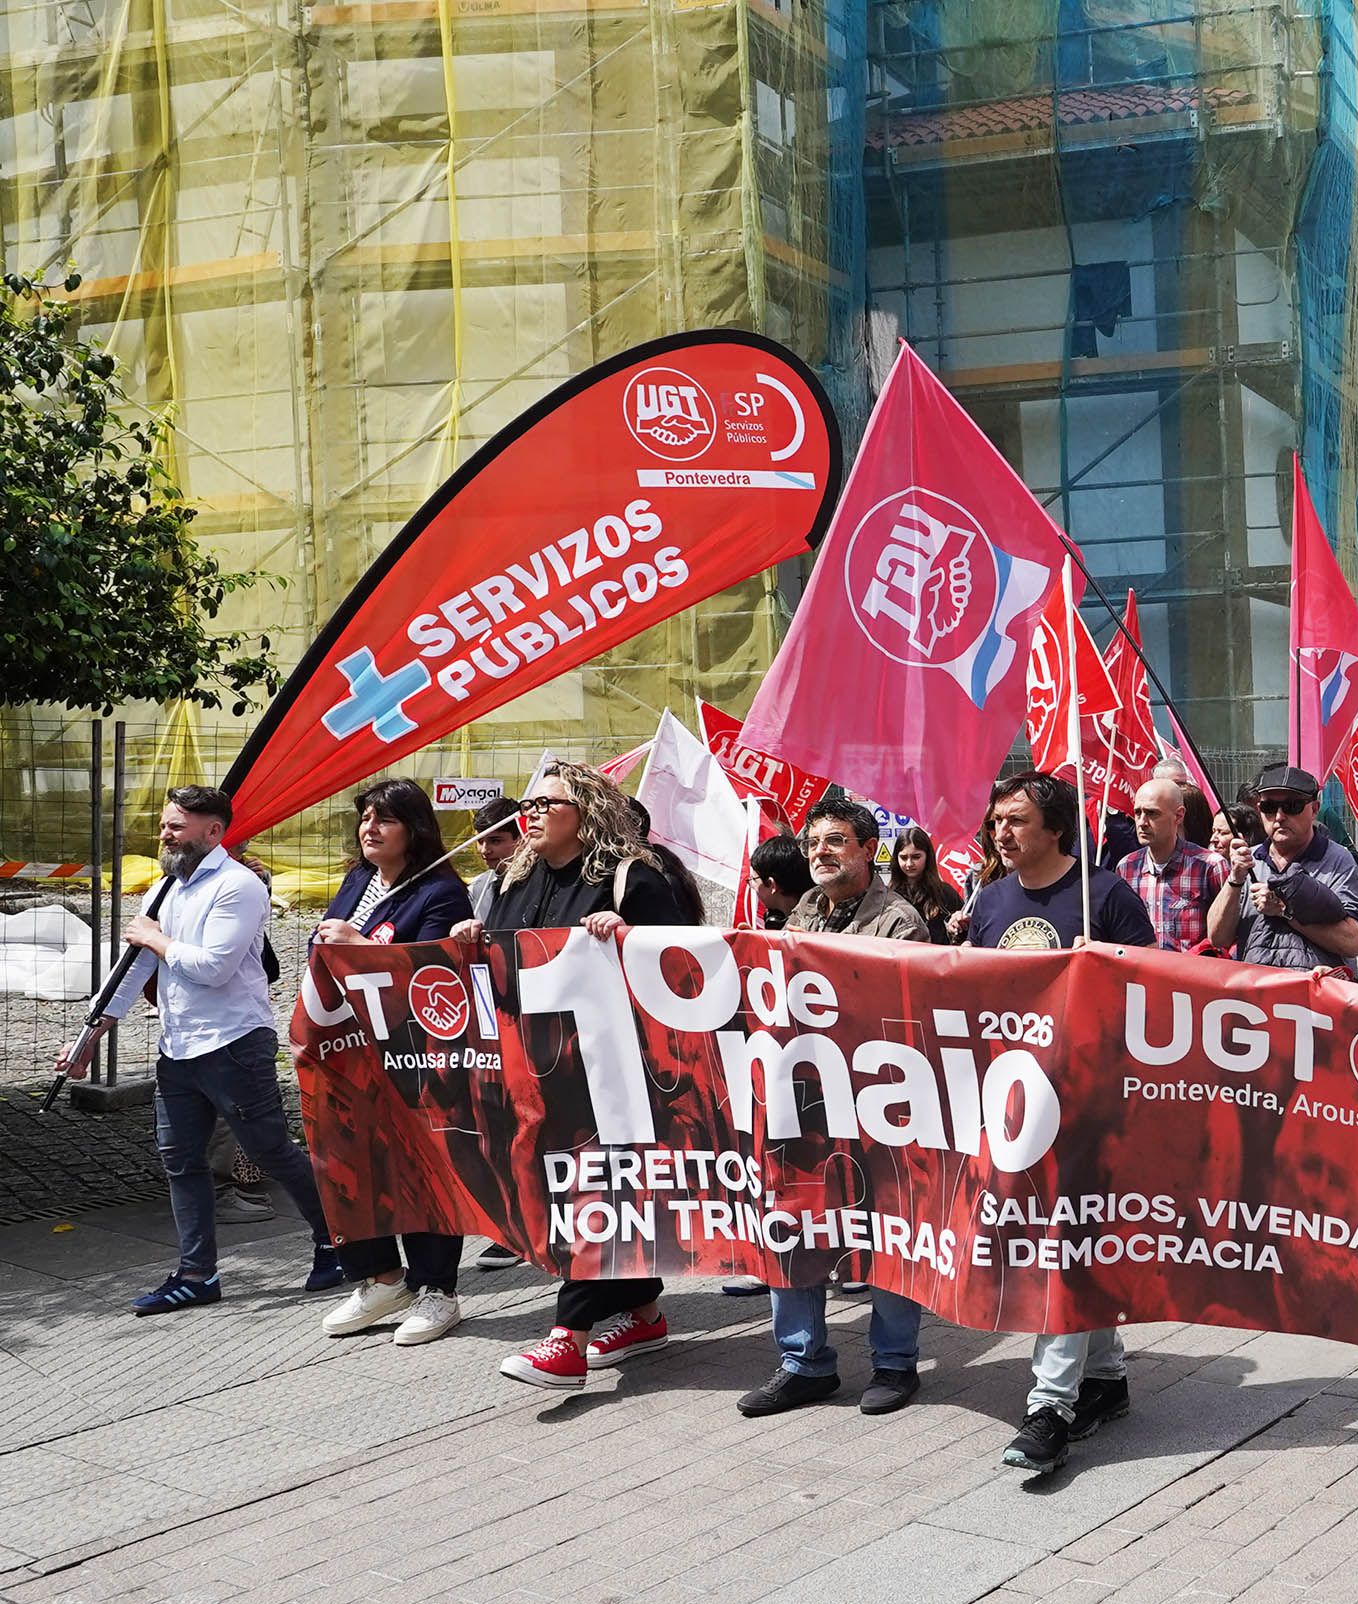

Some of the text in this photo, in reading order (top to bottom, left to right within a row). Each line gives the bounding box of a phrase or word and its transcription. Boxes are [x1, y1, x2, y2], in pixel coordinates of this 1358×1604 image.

[636, 383, 700, 419] UGT
[734, 392, 765, 417] SP
[724, 420, 764, 432] Servizos
[726, 432, 767, 444] Públicos
[664, 471, 751, 486] Pontevedra
[407, 499, 664, 659] SERVIZOS
[437, 546, 690, 702] PÚBLICOS
[1001, 920, 1055, 947] ORGULLO
[747, 950, 839, 1028] de
[978, 1011, 1054, 1048] 2026
[1125, 982, 1334, 1082] UGT
[384, 1048, 502, 1070] Arousa e Deza
[716, 1009, 1061, 1172] maio
[1123, 1076, 1284, 1116] Pontevedra,
[543, 1149, 775, 1208] DEREITOS,
[548, 1201, 655, 1245] NON
[980, 1191, 1186, 1229] SALARIOS,
[971, 1232, 1284, 1275] E DEMOCRACIA
